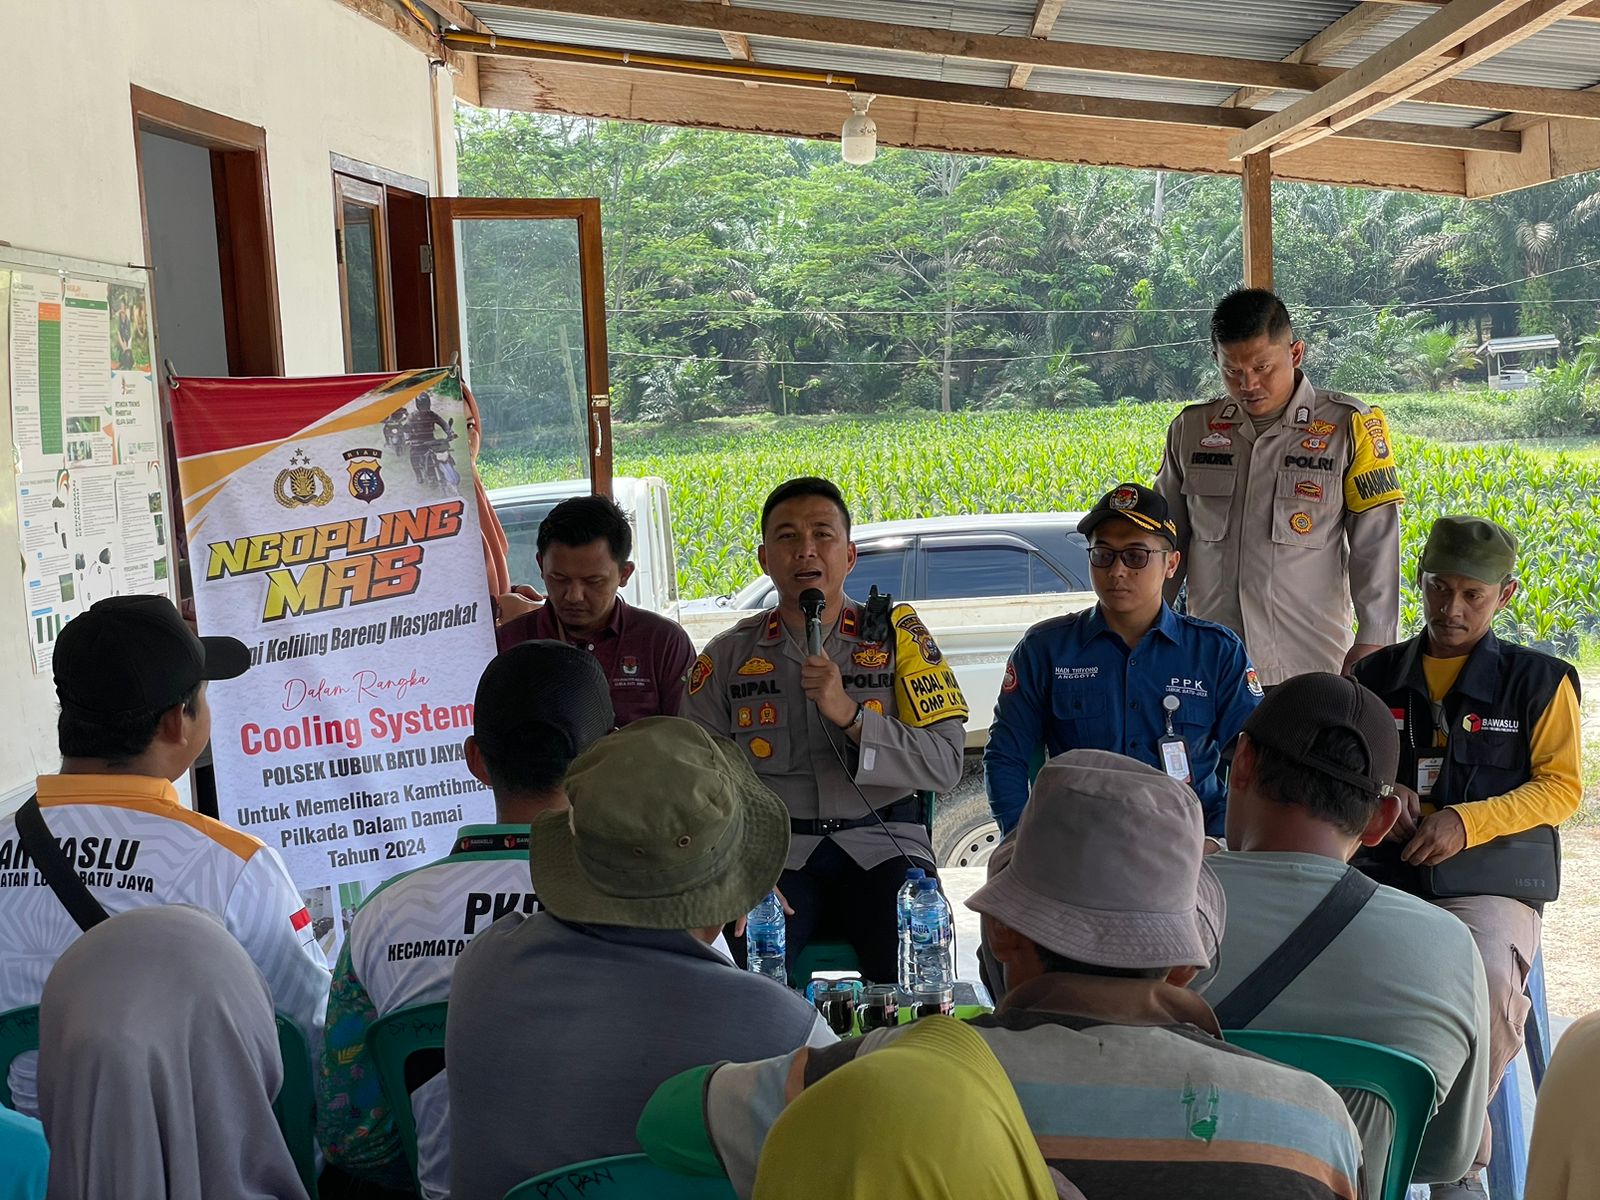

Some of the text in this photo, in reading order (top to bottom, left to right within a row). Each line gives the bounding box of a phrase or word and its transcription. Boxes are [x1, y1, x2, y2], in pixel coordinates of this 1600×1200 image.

[346, 449, 378, 459] RIAU
[1284, 455, 1335, 471] POLRI
[206, 500, 464, 581] NGOPLING
[262, 545, 425, 623] MAS
[266, 631, 327, 665] Keliling
[331, 621, 387, 651] Bareng
[389, 601, 478, 640] Masyarakat
[282, 669, 430, 711] Dalam Rangka
[730, 679, 781, 700] RIPAL
[843, 672, 895, 690] POLRI
[910, 672, 944, 698] PADAL
[920, 694, 945, 714] OMP
[240, 703, 475, 756] Cooling System
[1482, 718, 1519, 729] BAWASLU
[262, 743, 465, 787] POLSEK LUBUK BATU JAYA
[237, 803, 291, 826] Untuk
[296, 790, 400, 818] Memelihara
[280, 804, 463, 848] Pilkada Dalam Damai
[327, 838, 426, 868] Tahun 2024
[80, 871, 113, 888] BATU
[117, 874, 154, 893] JAYA
[387, 939, 471, 962] KECAMATA
